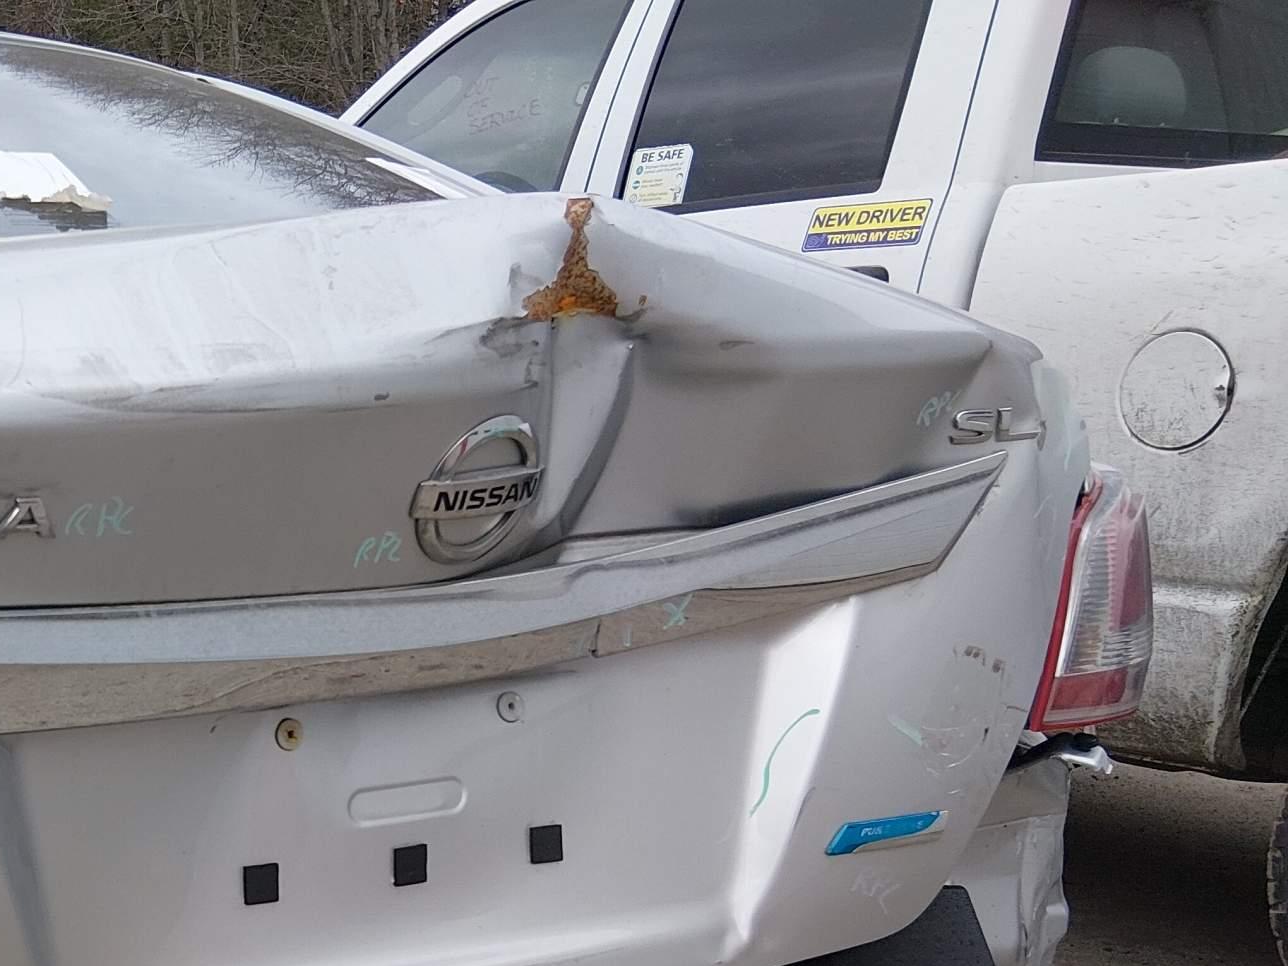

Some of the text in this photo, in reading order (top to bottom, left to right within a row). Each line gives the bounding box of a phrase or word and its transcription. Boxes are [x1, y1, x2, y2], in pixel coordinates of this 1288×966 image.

[641, 149, 685, 163] BE SAFE
[812, 206, 926, 229] NEW DRIVER
[827, 228, 920, 246] TRYING MY BEST
[948, 407, 1042, 446] SL
[433, 478, 538, 513] NISSAN
